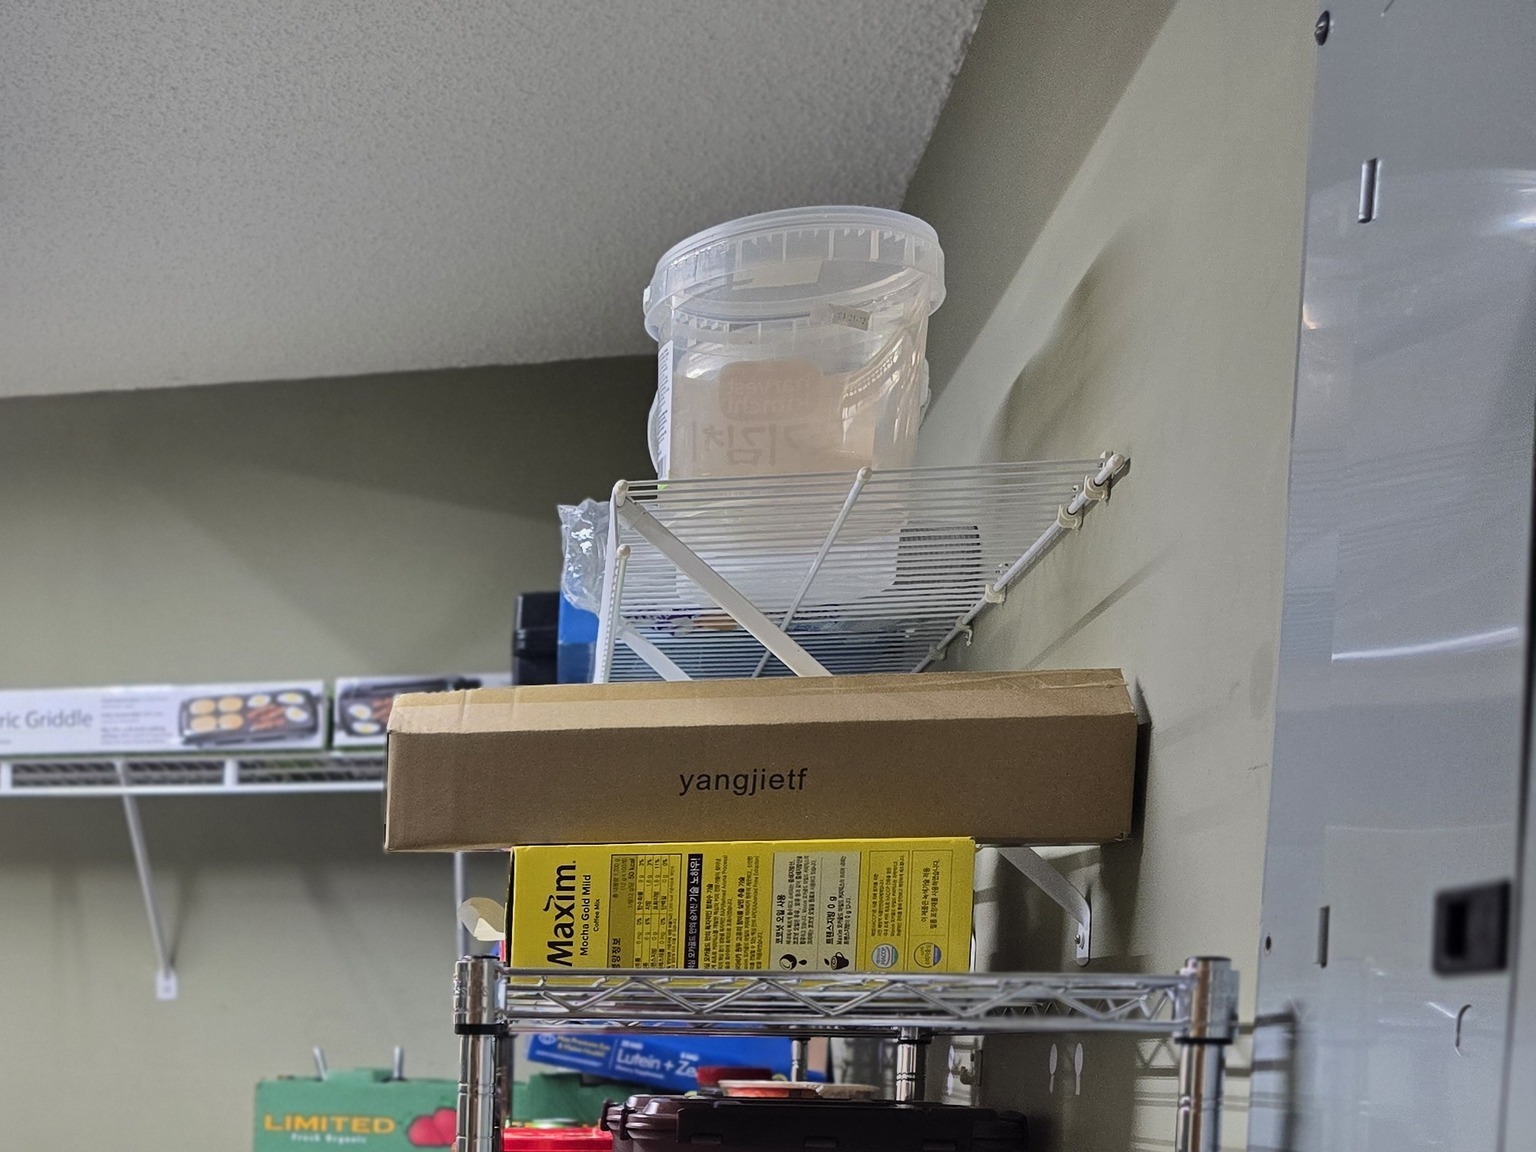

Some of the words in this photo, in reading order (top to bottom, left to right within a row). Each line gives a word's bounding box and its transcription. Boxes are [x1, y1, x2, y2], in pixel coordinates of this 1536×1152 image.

[25, 710, 93, 729] Griddle
[679, 768, 808, 796] yangjietf
[690, 858, 700, 884] 노하우!
[580, 874, 591, 897] Mild
[689, 887, 699, 902] 기술
[580, 899, 591, 921] Gold
[777, 895, 786, 907] 사용
[544, 863, 576, 967] Maxim
[776, 910, 785, 922] 오일
[689, 922, 697, 934] 안의
[775, 925, 784, 944] 코코넛
[826, 911, 835, 944] 트랜스지방
[580, 923, 591, 956] Mocha
[688, 935, 696, 958] 모카골드
[616, 1048, 661, 1070] Lutein
[663, 1061, 674, 1071] +
[264, 1114, 396, 1134] LIMITED
[291, 1133, 321, 1143] Fresh
[325, 1133, 367, 1144] Organic
